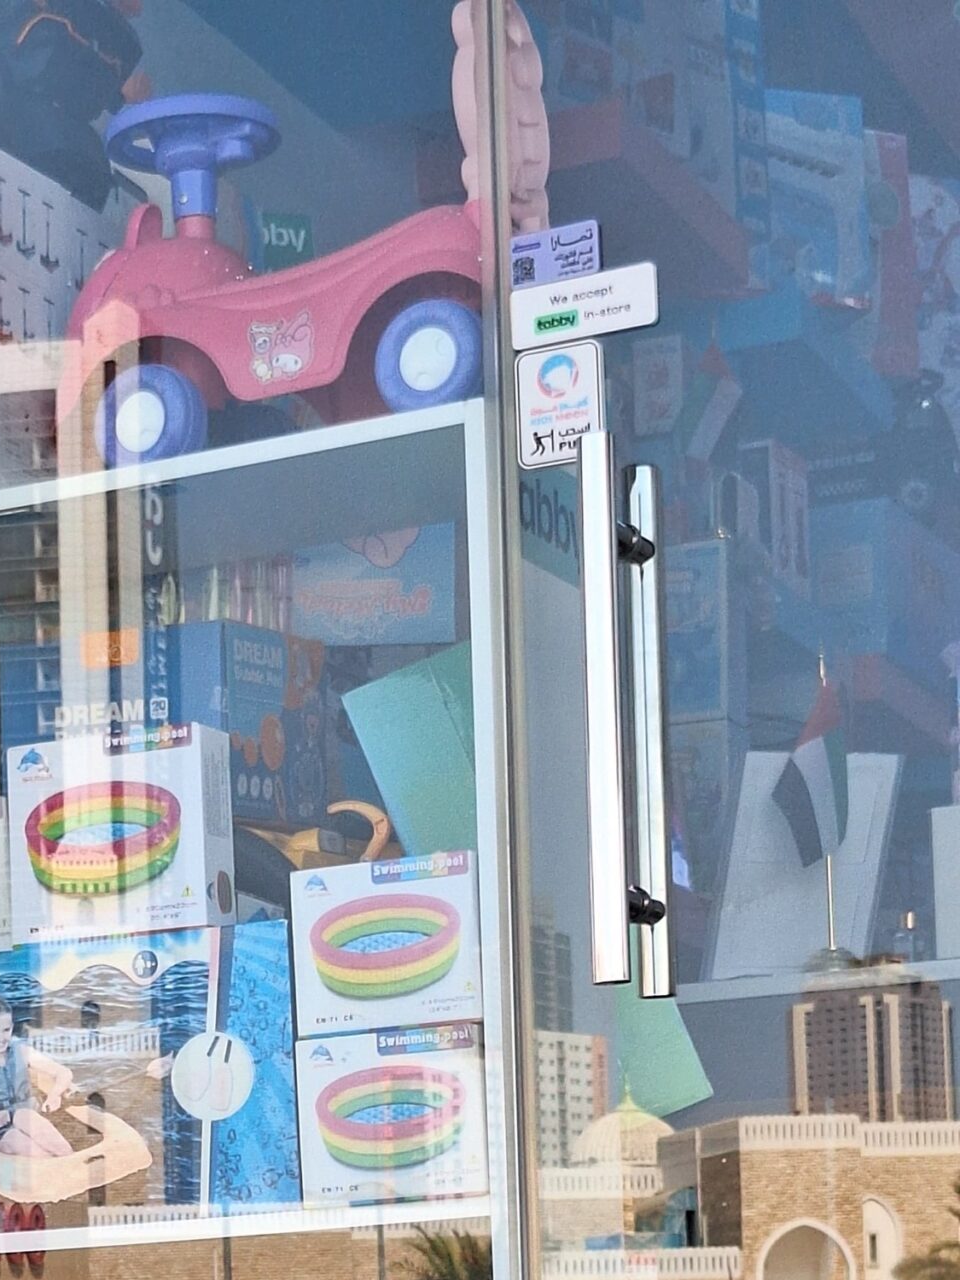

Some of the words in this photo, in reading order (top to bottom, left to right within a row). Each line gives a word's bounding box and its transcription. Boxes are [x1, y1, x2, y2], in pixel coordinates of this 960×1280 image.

[549, 295, 569, 306] We
[572, 285, 614, 304] accept
[536, 312, 577, 331] tabby
[559, 440, 578, 452] PU
[55, 699, 144, 728] DREAM
